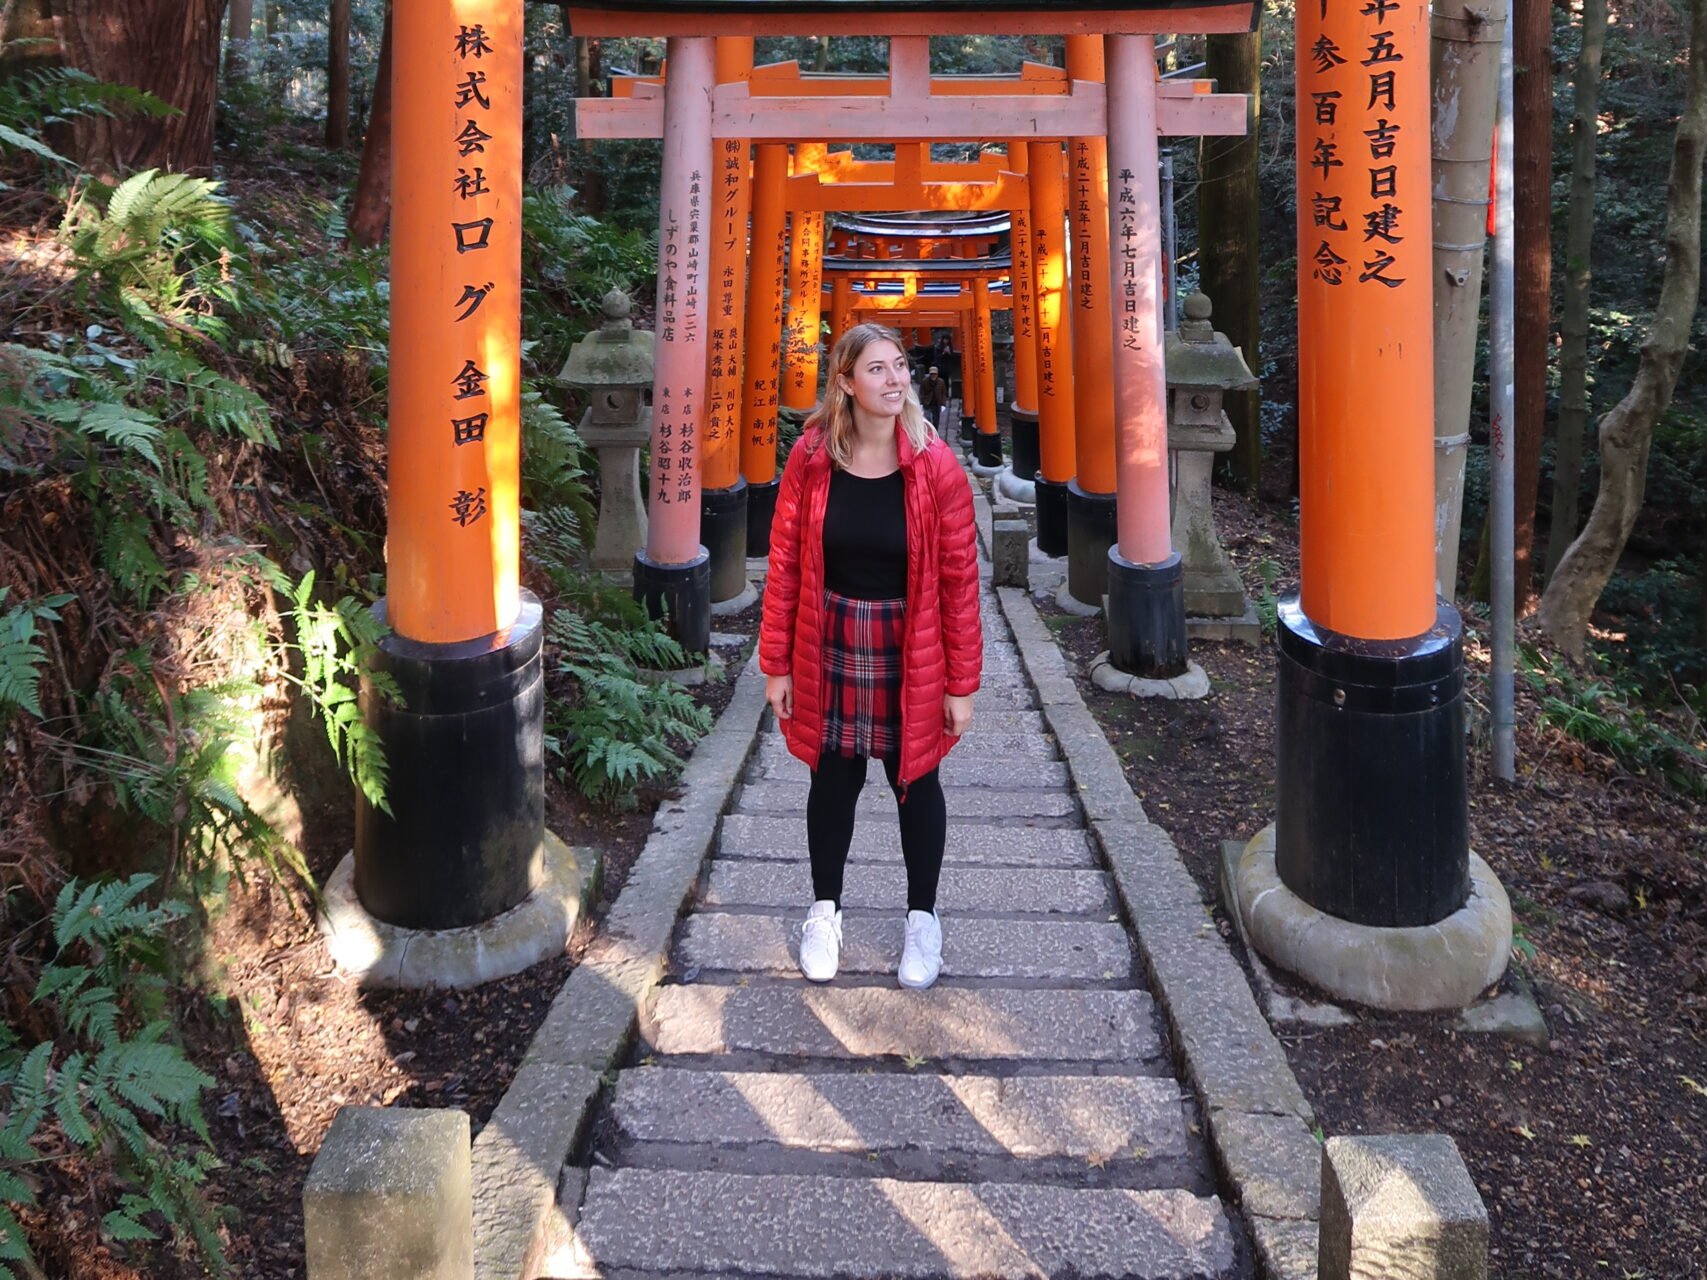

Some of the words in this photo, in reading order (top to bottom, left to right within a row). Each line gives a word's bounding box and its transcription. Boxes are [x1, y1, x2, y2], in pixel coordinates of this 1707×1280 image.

[662, 208, 679, 342] しずのや食料品店
[1076, 142, 1094, 310] 平成二十五年二月吉日建之
[1118, 169, 1142, 351] 平成六年七月吉日建之
